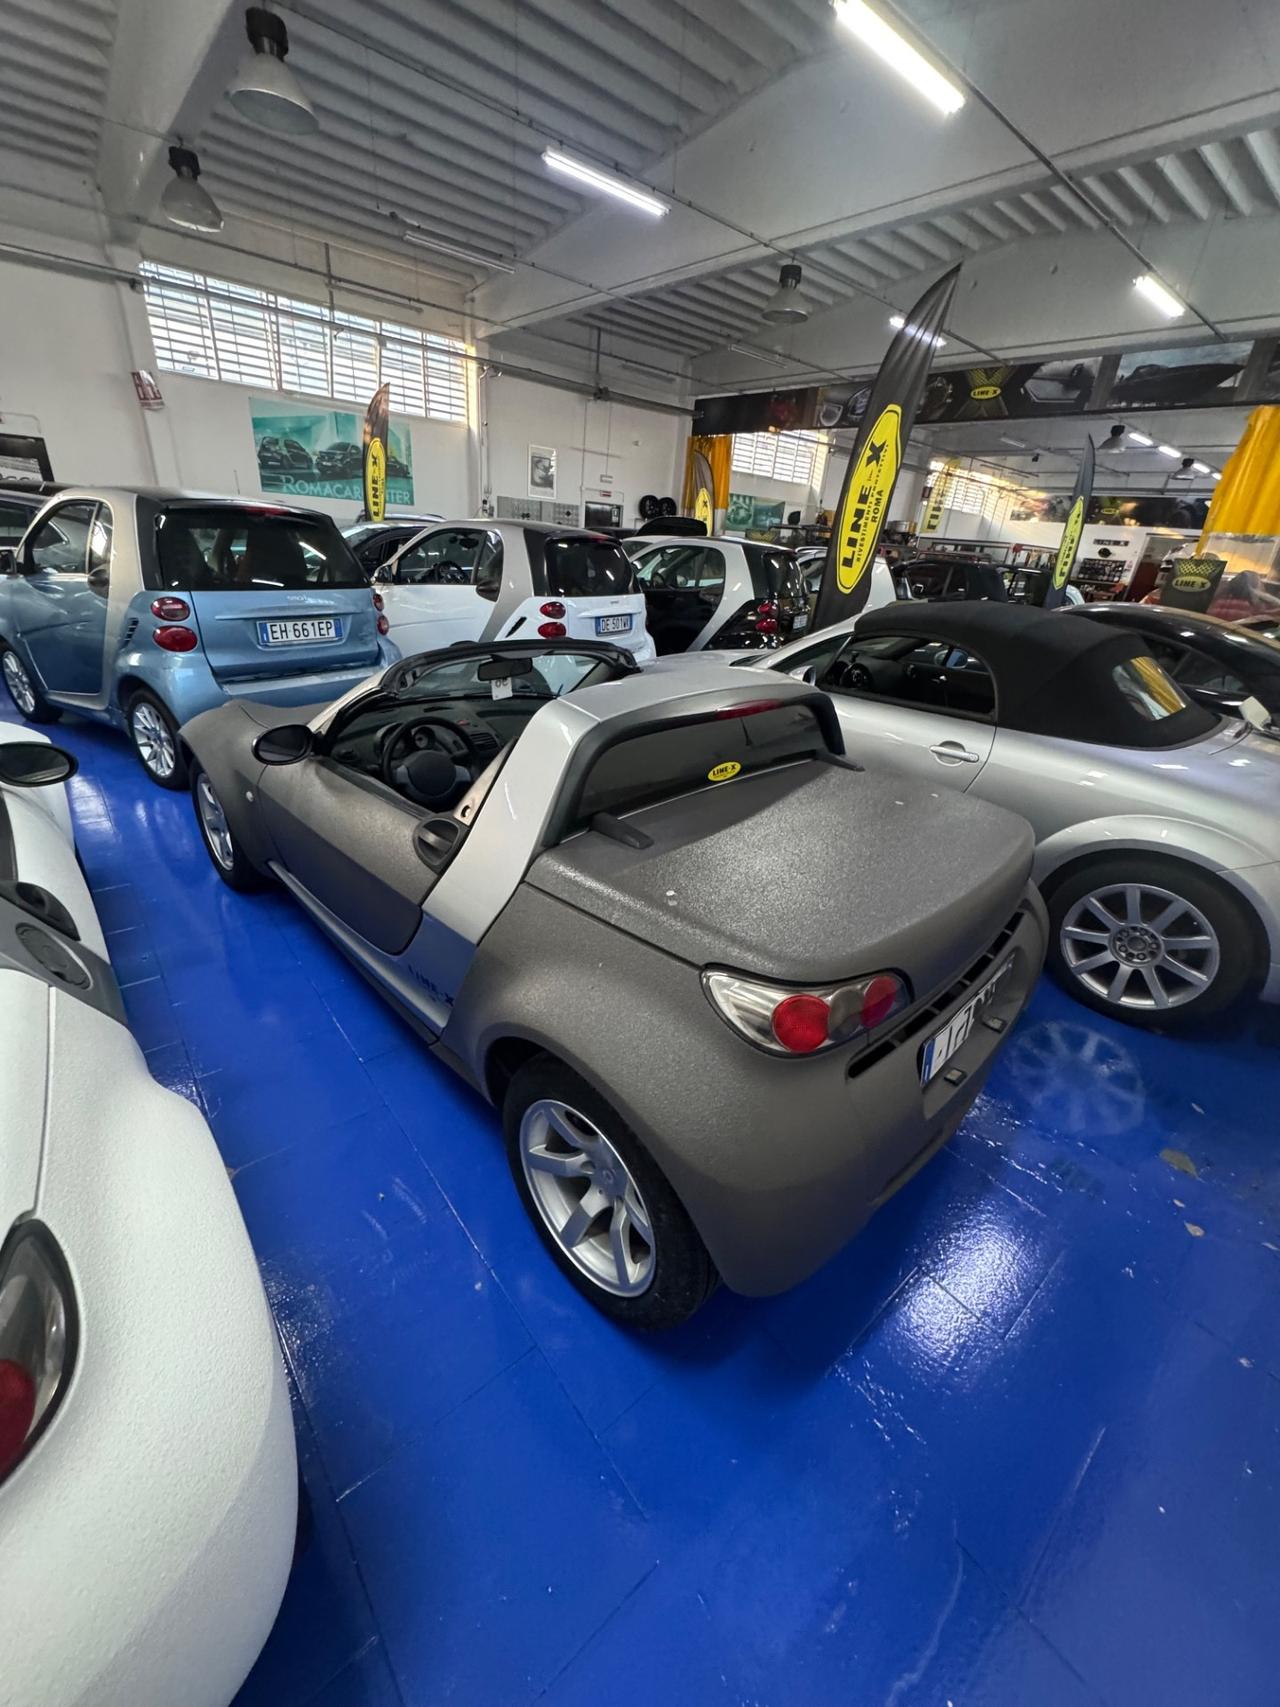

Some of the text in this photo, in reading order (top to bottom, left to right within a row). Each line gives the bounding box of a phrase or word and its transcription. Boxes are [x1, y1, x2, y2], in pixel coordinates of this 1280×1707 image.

[870, 489, 884, 523] ROMA
[269, 621, 333, 640] EH 661EP
